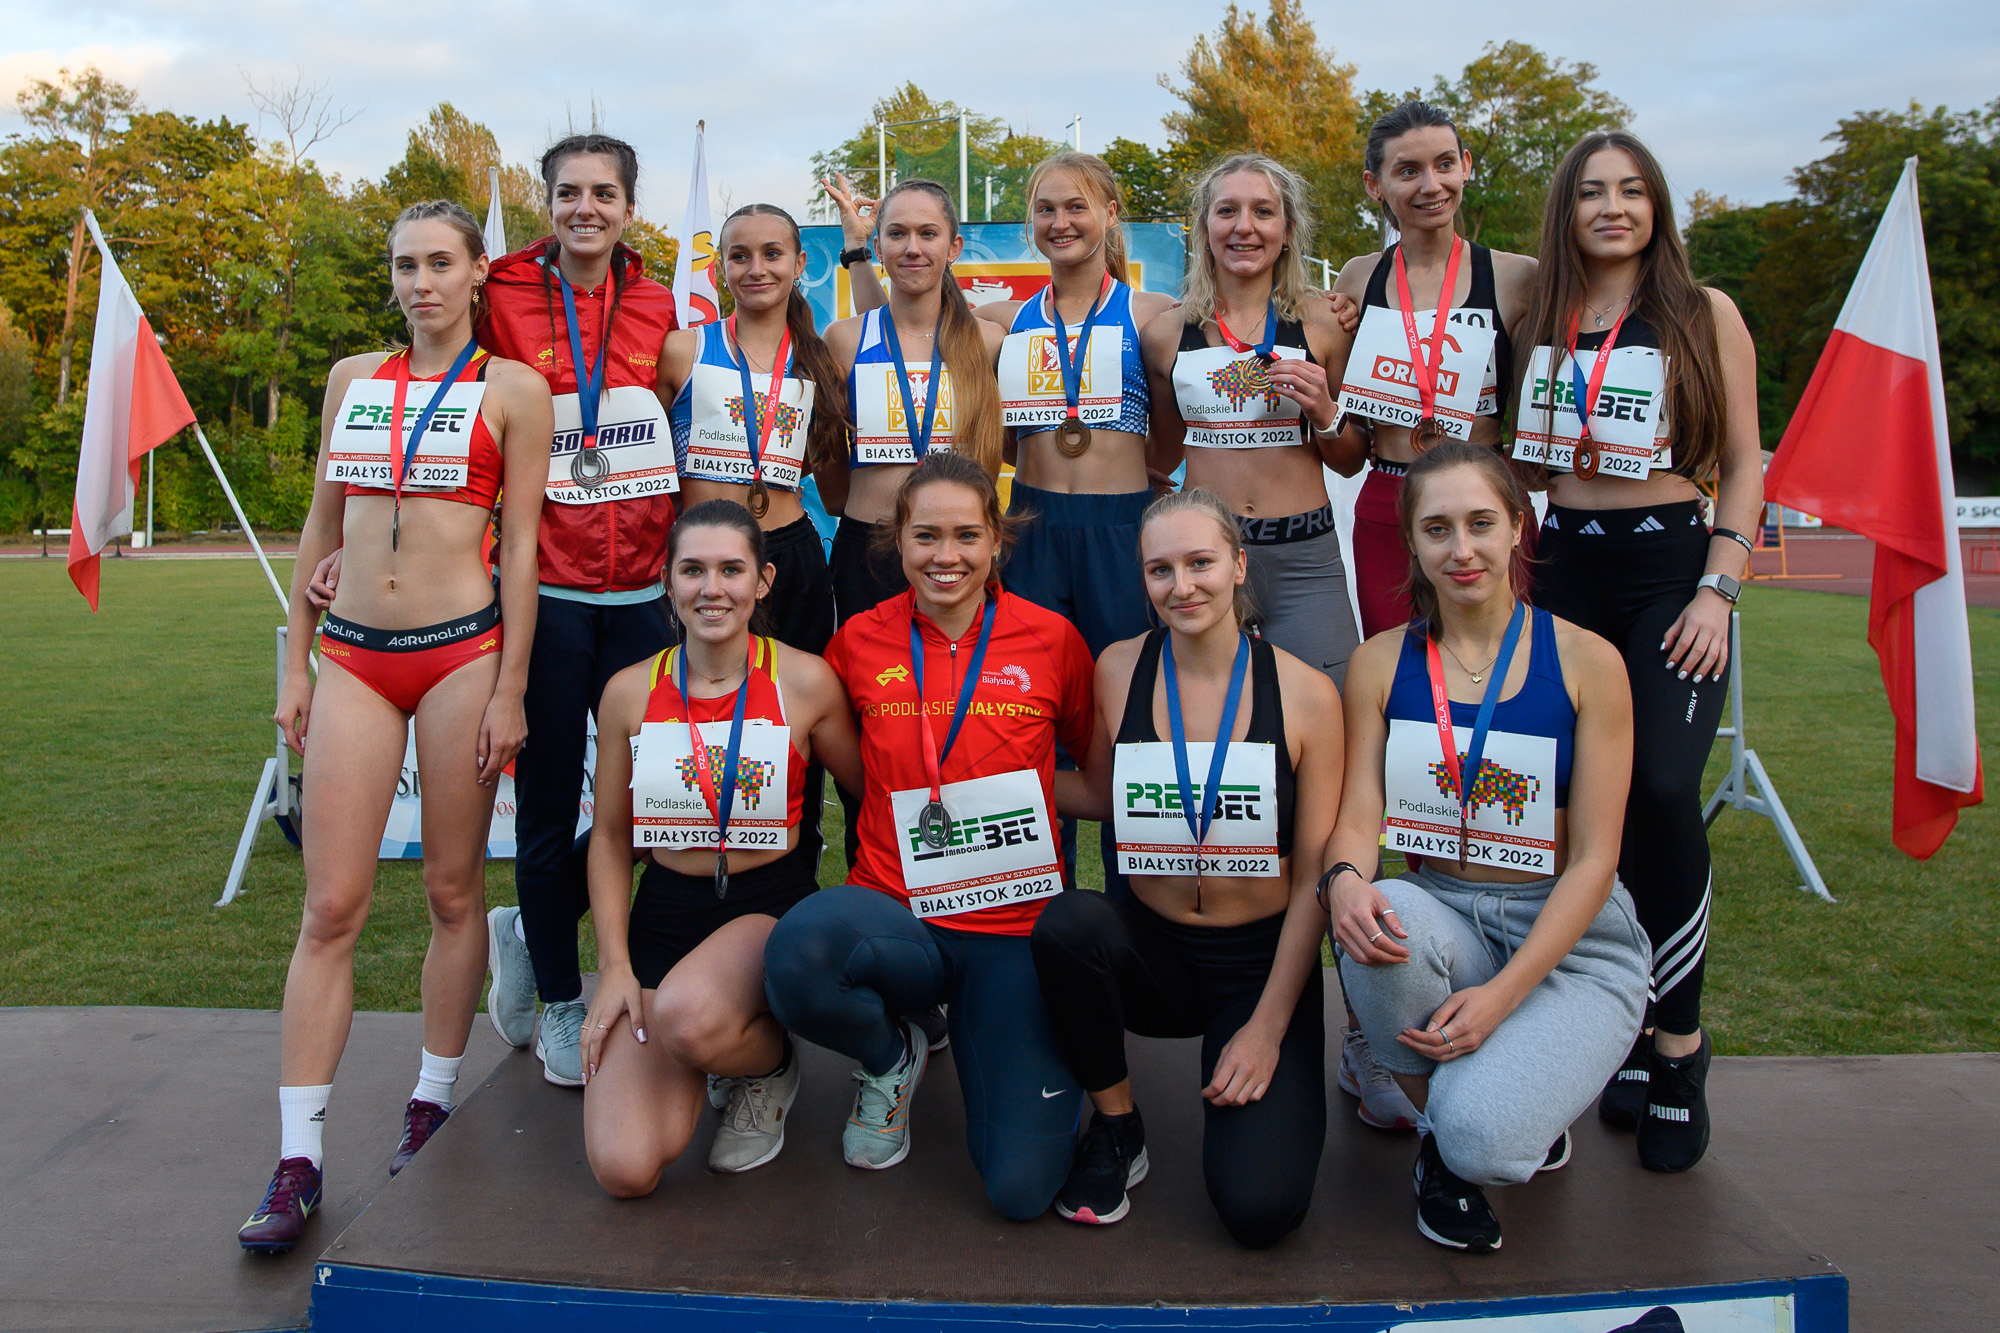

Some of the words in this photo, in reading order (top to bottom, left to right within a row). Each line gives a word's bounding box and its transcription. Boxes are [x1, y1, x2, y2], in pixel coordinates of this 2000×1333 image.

[1408, 327, 1418, 349] PZLA
[1599, 342, 1611, 363] PZLA
[1377, 360, 1454, 393] ORLN
[769, 393, 777, 412] PZLA
[1344, 386, 1360, 394] PZLA
[1361, 389, 1404, 404] MISTRZOSTWA
[1404, 400, 1424, 408] POLSK
[1532, 378, 1652, 423] PREBET
[1006, 410, 1068, 423] BIAŁYSTO
[1082, 408, 1114, 420] 2022
[1186, 404, 1231, 415] Podlaskie
[1345, 397, 1423, 426] BIAŁYSTOK
[1437, 419, 1463, 436] 022
[698, 429, 746, 443] Podlaskie
[1192, 431, 1257, 445] BIAŁYSTOK
[1261, 430, 1294, 443] 2022
[706, 448, 748, 458] MISTRZOSTWA
[1522, 444, 1591, 466] BIAŁYSO
[1604, 457, 1642, 474] 2022
[1610, 445, 1649, 456] SZTAFETACH
[335, 465, 418, 480] BIAŁYSTK
[422, 468, 459, 482] 2022
[637, 467, 673, 477] SZTAFETACH
[693, 458, 768, 477] BIAŁYSTOK
[773, 467, 797, 482] 2022
[553, 483, 632, 501] BIAŁYSTOK
[636, 478, 671, 493] 2022
[1286, 503, 1334, 539] PRO
[982, 675, 1016, 687] Białystok
[881, 700, 955, 717] PODLASIE
[965, 702, 1042, 717] IAŁYSTOK
[1439, 704, 1449, 732] PZLA
[697, 743, 707, 770] PZLA
[645, 797, 703, 810] Podlaskie
[1398, 798, 1460, 819] Podlaskie
[657, 818, 708, 826] MISTRZOSTWA
[643, 830, 733, 844] BIAŁYSTOK
[738, 831, 778, 845] 2022
[1391, 818, 1410, 828] PZLA
[1411, 821, 1461, 835] MISTRZOSTW
[1502, 835, 1550, 849] SZTAFETACH
[945, 843, 987, 858] ŚNIADOWO
[1121, 843, 1140, 851] PZLA
[1140, 844, 1193, 852] MISTRZOSTWA
[1396, 832, 1493, 861] BIAŁYSOK
[1498, 848, 1544, 868] 2022
[1127, 856, 1222, 872] BIAŁYSTOK
[1226, 859, 1270, 873] 2022
[911, 888, 930, 896] PZLA
[930, 879, 980, 894] MISTRZOSTWA
[980, 875, 1005, 885] POLSKI
[1013, 866, 1056, 878] SZTAFETACH
[919, 886, 1009, 914] BIAŁYSTOK
[1013, 878, 1054, 898] 2022
[1649, 1102, 1690, 1122] PUMA
